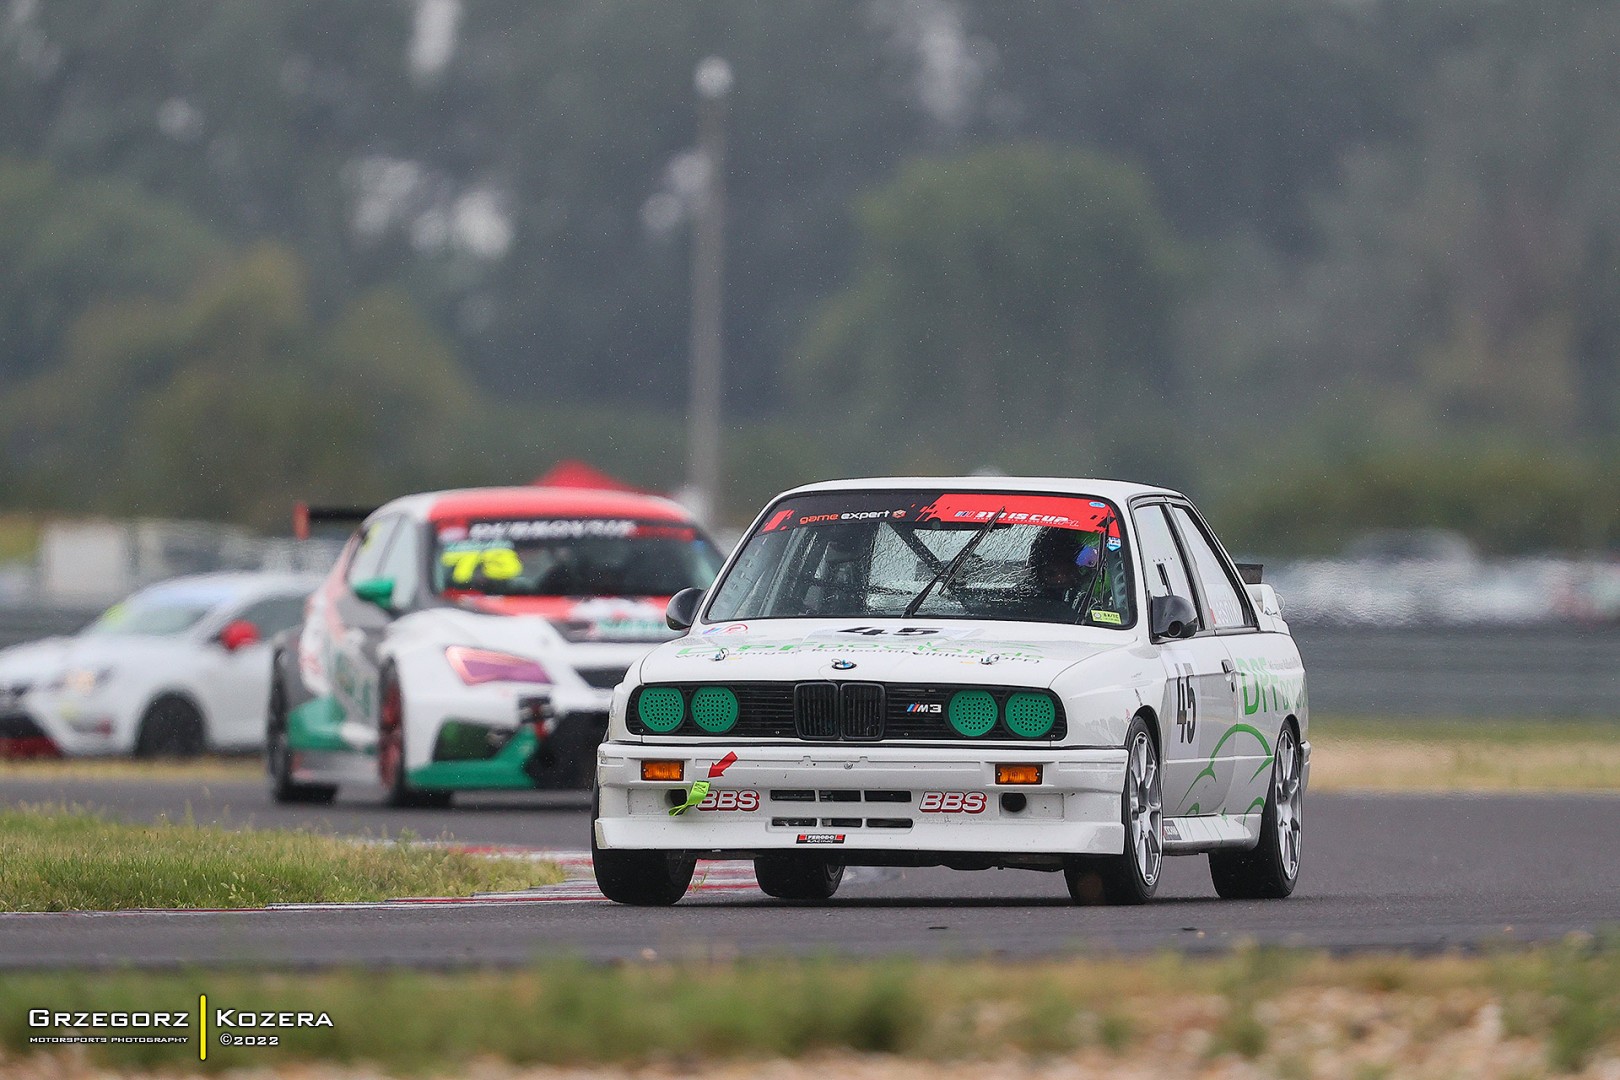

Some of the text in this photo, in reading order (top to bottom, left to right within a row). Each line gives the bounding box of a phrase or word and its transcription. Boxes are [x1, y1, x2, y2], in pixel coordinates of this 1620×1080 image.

[799, 510, 890, 525] game expert
[836, 626, 940, 636] 45
[915, 703, 942, 713] M3
[1174, 662, 1197, 744] 45
[697, 789, 760, 811] BBS
[918, 791, 988, 813] BBS
